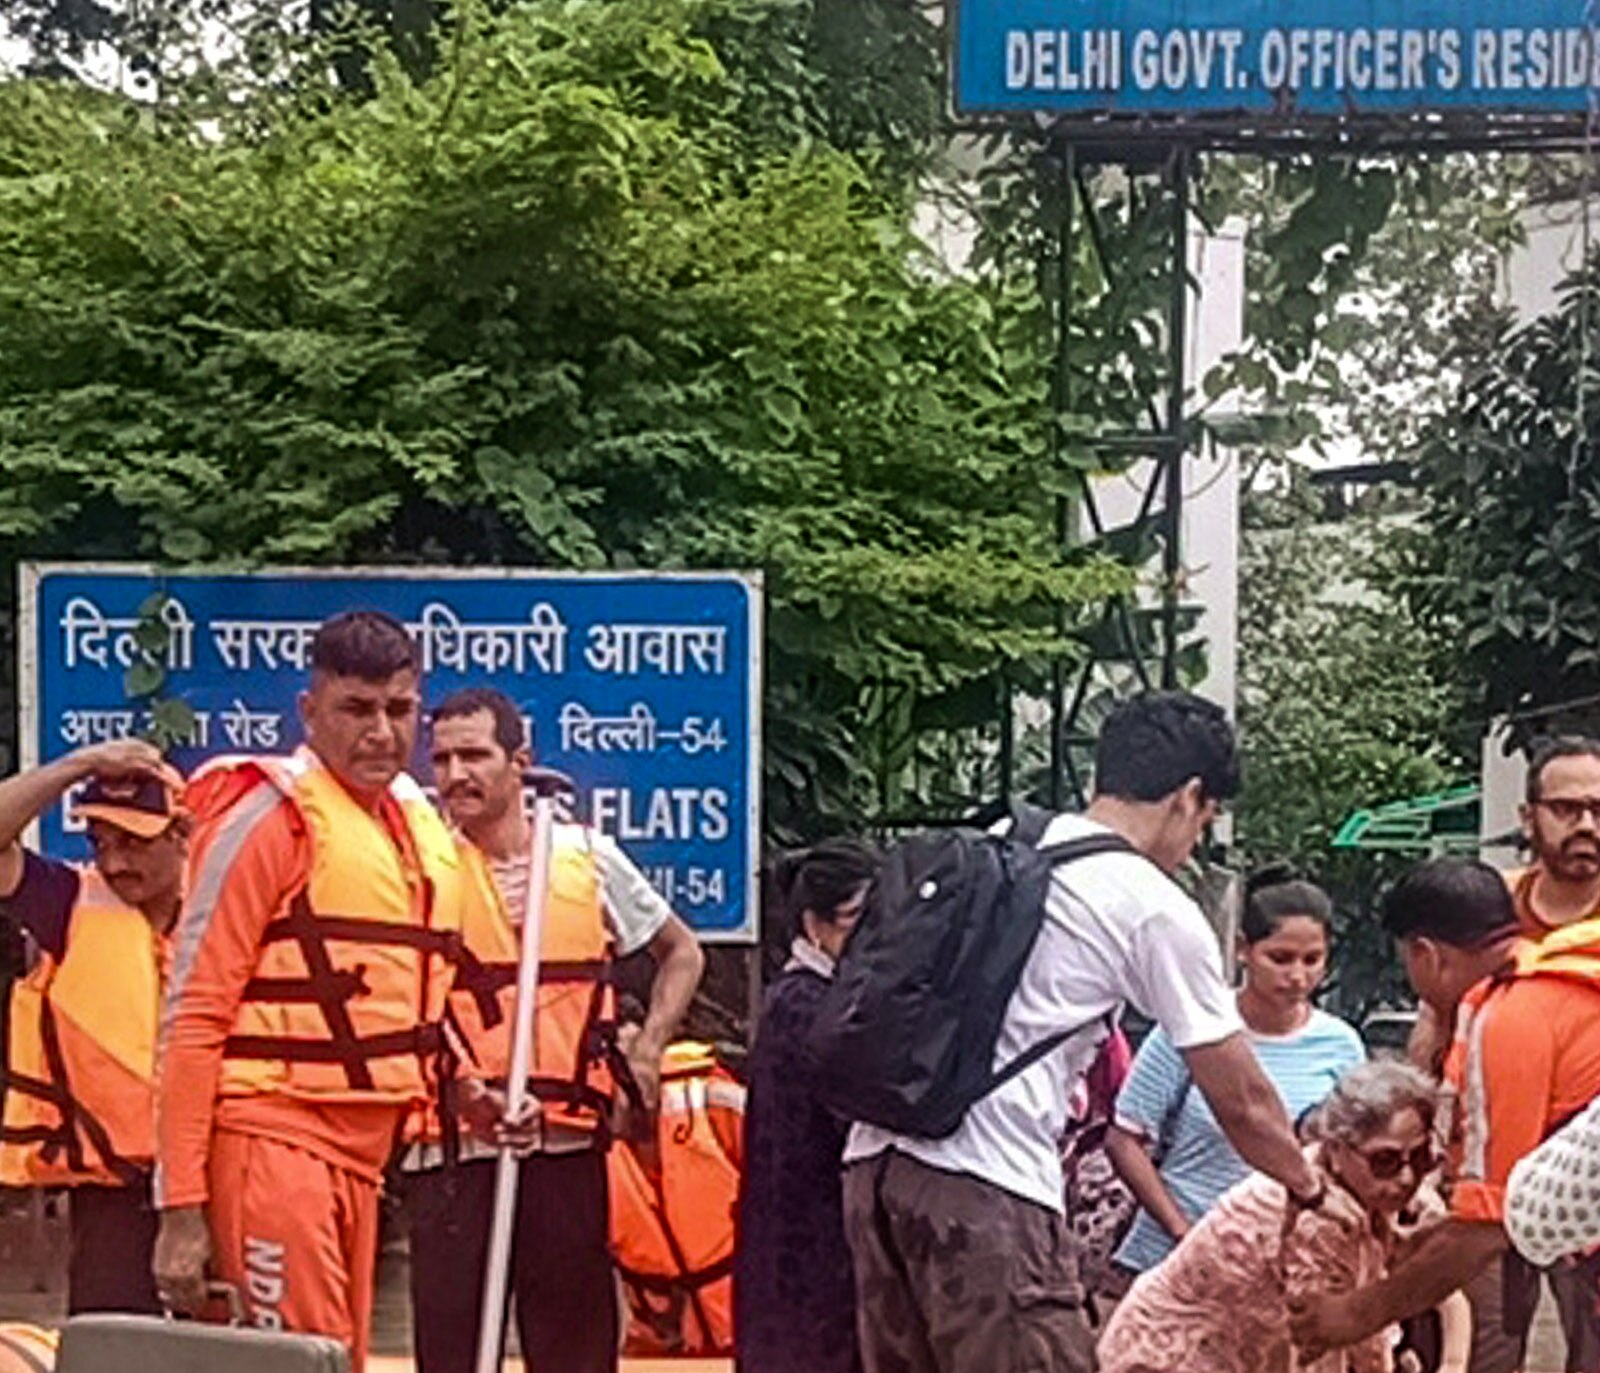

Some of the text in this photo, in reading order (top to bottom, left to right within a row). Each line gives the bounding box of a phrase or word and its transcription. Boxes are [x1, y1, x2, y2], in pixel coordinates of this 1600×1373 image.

[1006, 30, 1120, 90] DELHI
[1133, 29, 1247, 90] GOVT.
[1260, 28, 1461, 90] OFFICER'S
[583, 624, 727, 675] आवास
[220, 700, 281, 748] रोड
[593, 787, 729, 840] FLATS
